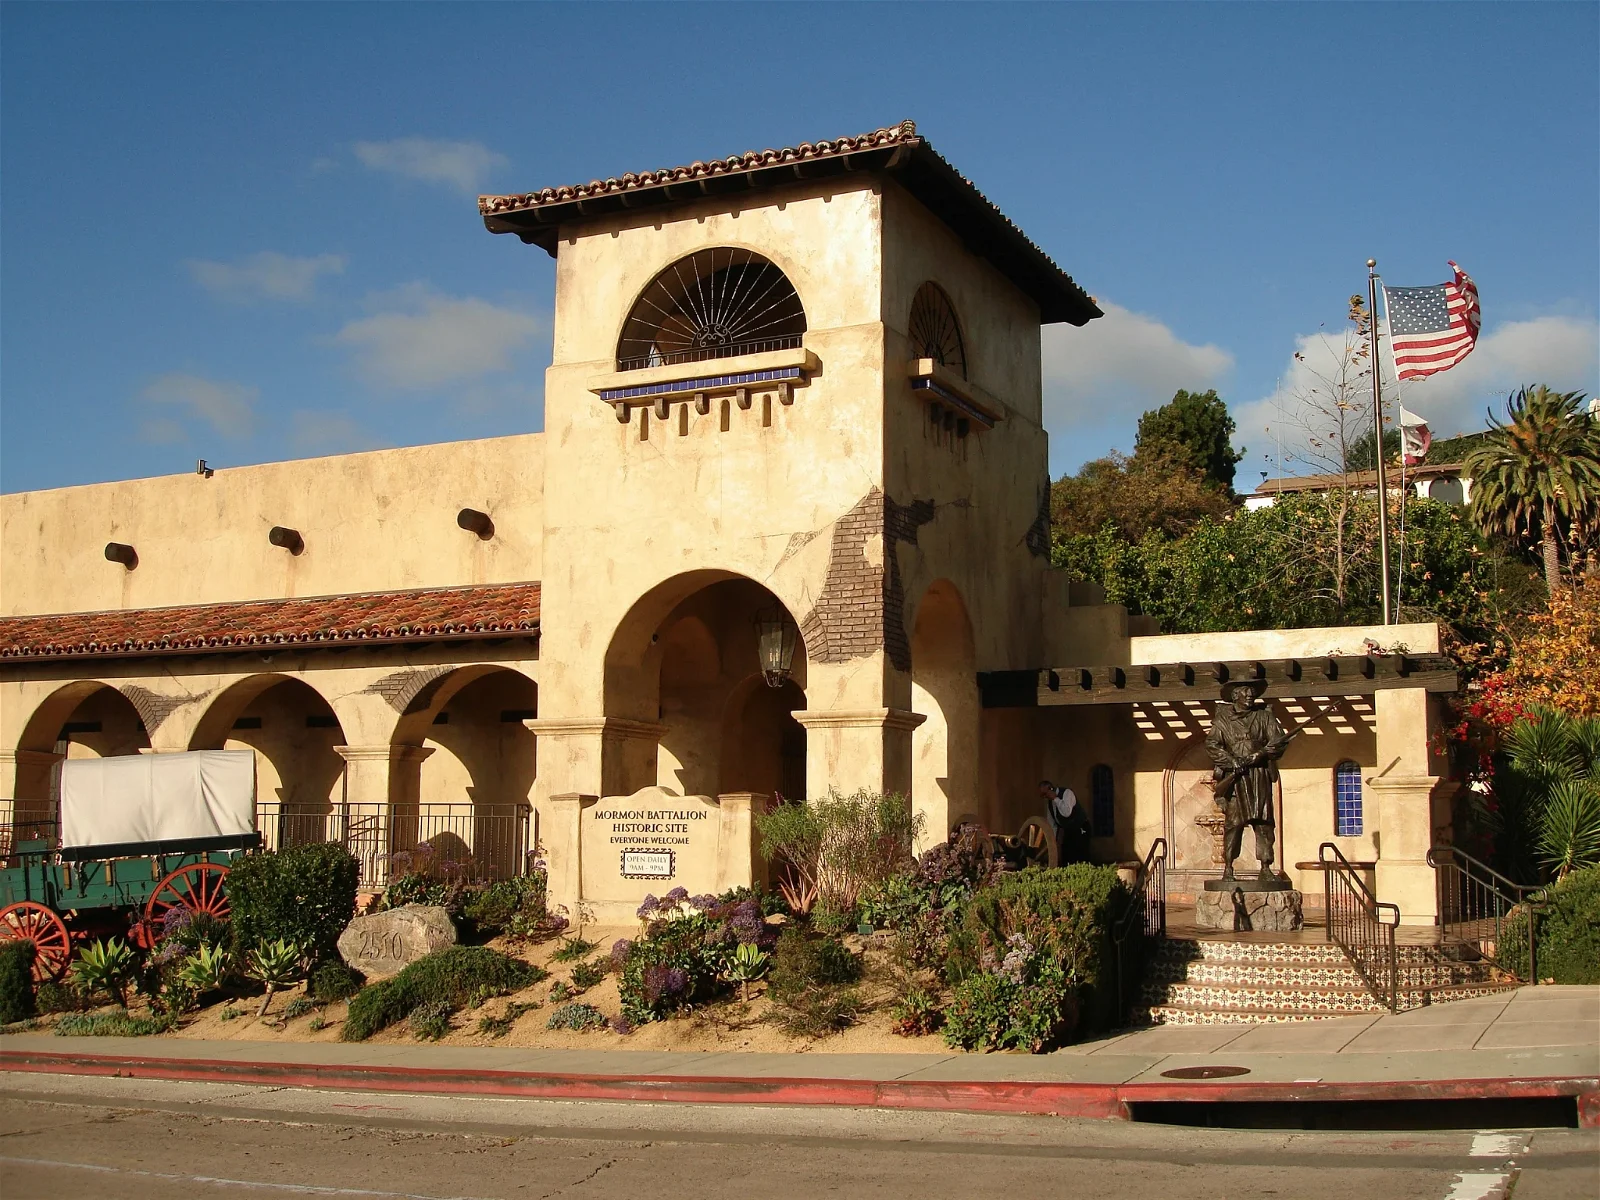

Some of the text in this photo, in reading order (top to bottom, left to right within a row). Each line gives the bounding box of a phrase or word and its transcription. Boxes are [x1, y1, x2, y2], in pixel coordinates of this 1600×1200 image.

[595, 811, 707, 820] MORMON BATTALION
[613, 824, 688, 833] HISTORIC SITE
[610, 836, 690, 845] EVERYONE WELCOME
[647, 856, 668, 864] DAILY
[359, 931, 402, 960] 2510
